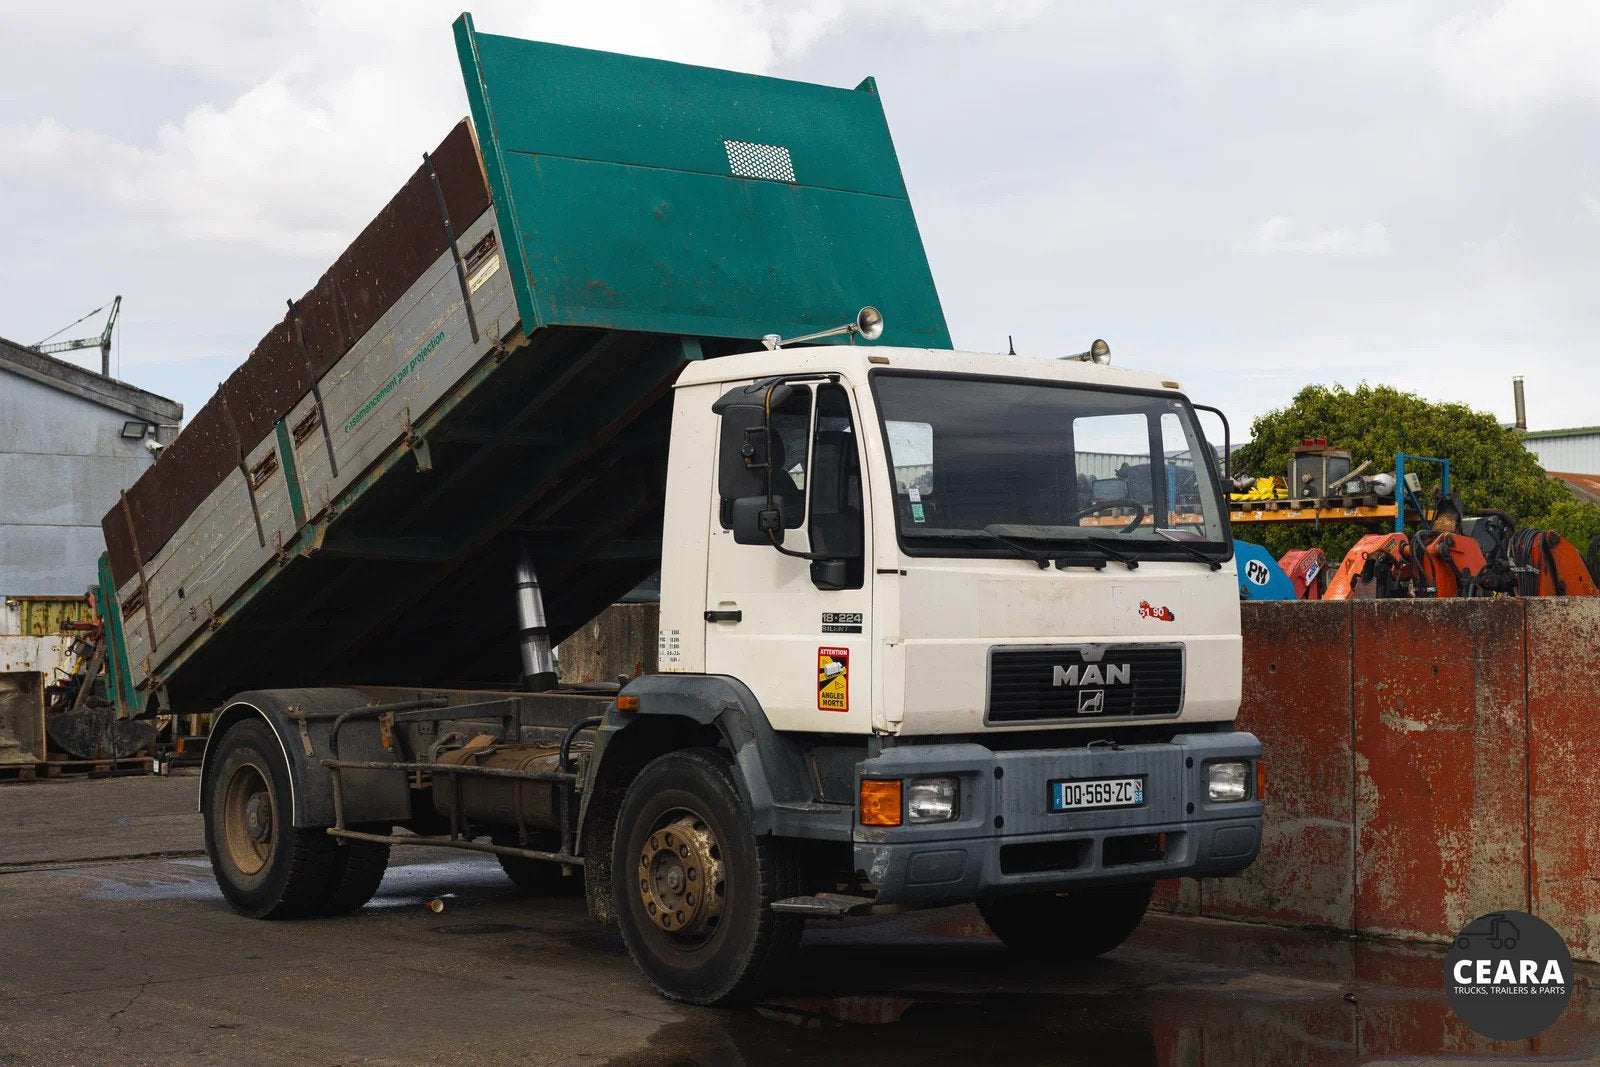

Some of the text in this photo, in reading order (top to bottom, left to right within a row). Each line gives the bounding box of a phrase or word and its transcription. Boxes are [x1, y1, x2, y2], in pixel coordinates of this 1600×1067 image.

[344, 331, 445, 433] ensemencement par projection
[1248, 561, 1269, 584] PM
[1153, 607, 1164, 617] 90
[1053, 664, 1131, 687] MAN
[821, 692, 845, 700] ANGLES
[822, 700, 844, 708] MORTS
